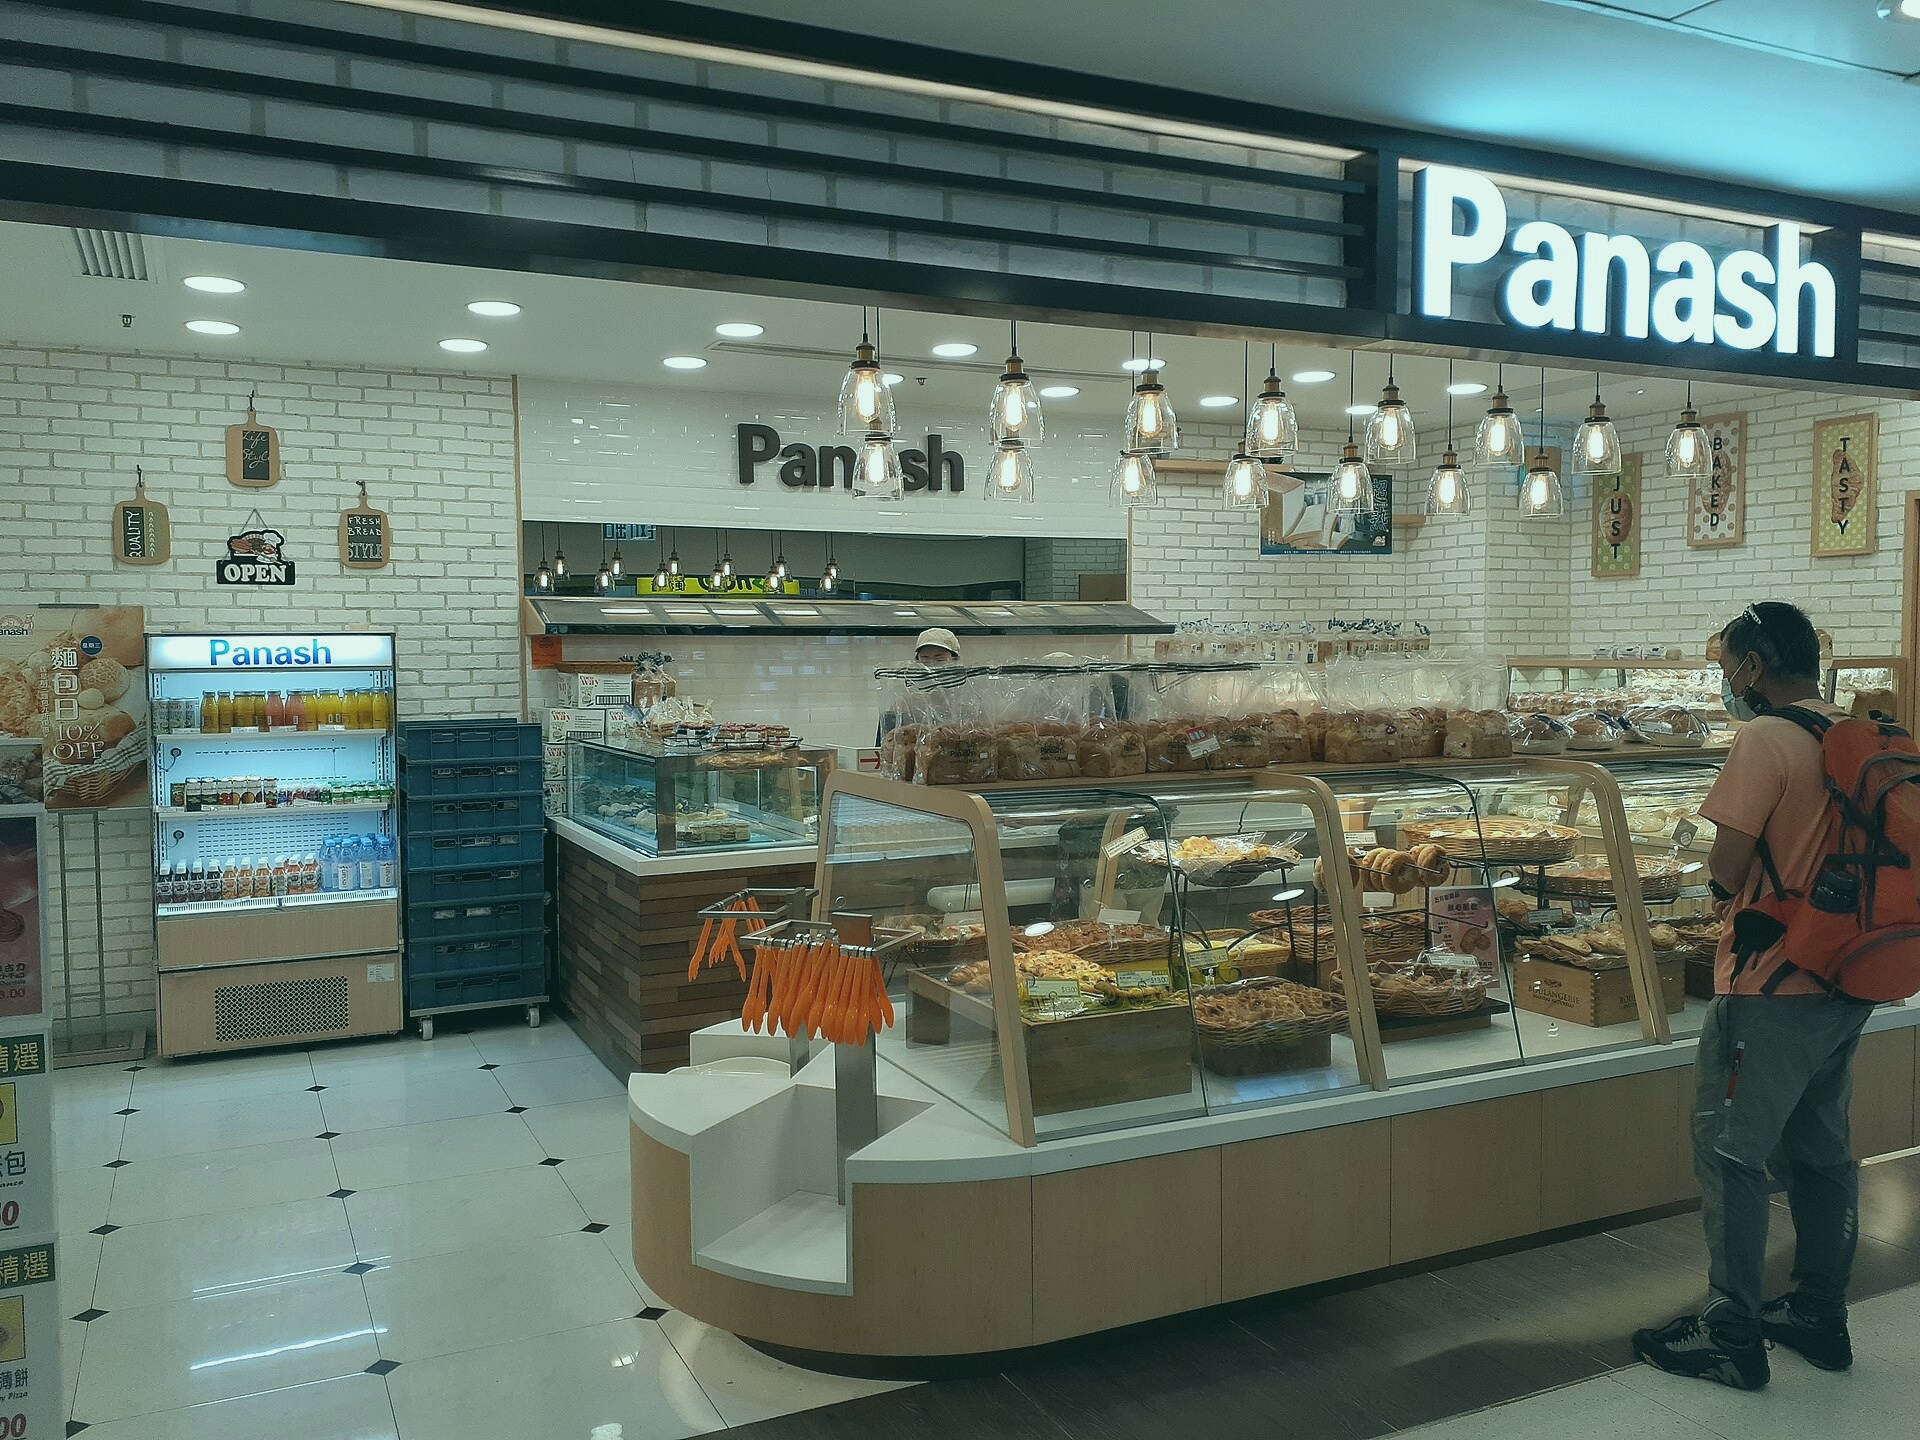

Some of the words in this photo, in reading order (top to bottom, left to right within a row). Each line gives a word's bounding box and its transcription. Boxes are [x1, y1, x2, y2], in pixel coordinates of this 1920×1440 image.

[1423, 164, 1836, 358] Panash
[242, 448, 270, 469] Styl
[737, 422, 965, 492] Pansh
[1709, 436, 1723, 528] BAKED
[1836, 436, 1851, 535] TASTY
[348, 515, 381, 525] FRESH
[1611, 475, 1622, 559] JUST
[127, 510, 141, 557] QUALITY
[347, 526, 382, 536] BREAD
[224, 563, 287, 583] OPEN
[208, 638, 332, 666] Panash
[51, 647, 79, 721] 麵包日
[58, 720, 101, 741] 10%
[52, 741, 105, 760] OFF
[0, 963, 26, 973] 古力
[0, 1150, 27, 1177] 包
[0, 1200, 20, 1226] 0
